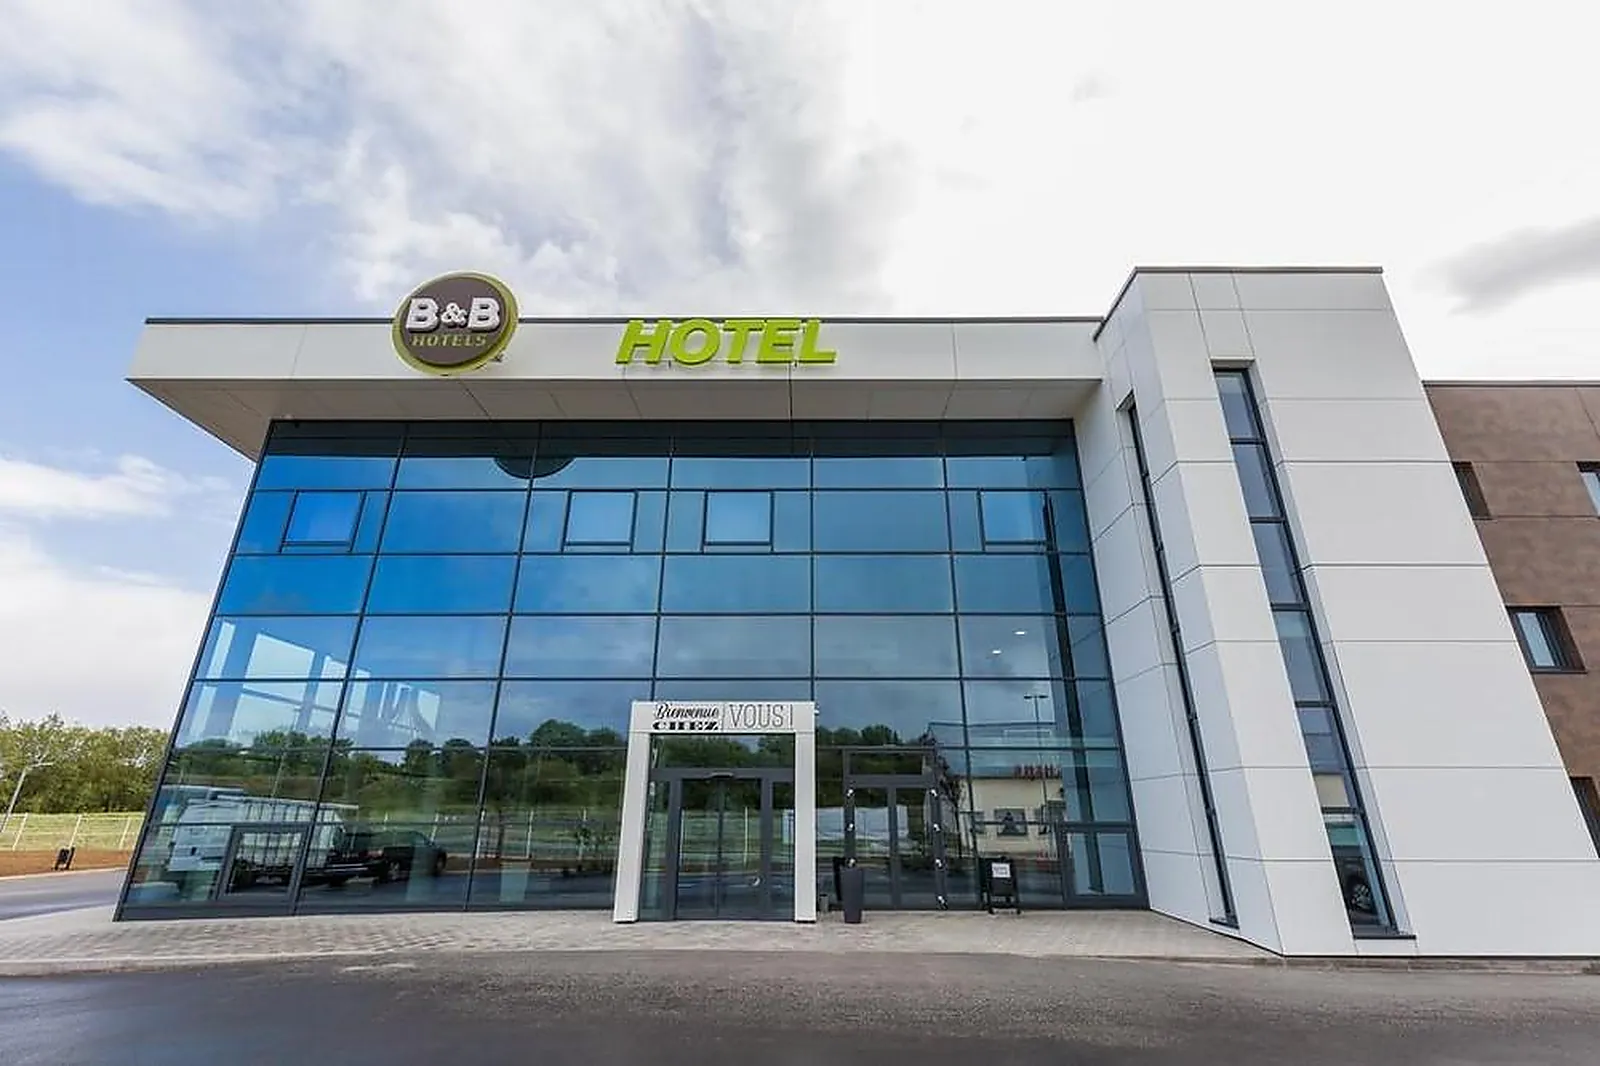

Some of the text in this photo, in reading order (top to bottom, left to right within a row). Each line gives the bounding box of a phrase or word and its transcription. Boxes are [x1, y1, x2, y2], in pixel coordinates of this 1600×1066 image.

[406, 297, 500, 331] B&B
[411, 334, 487, 347] HOTELS
[616, 318, 837, 365] HOTEL
[656, 703, 719, 719] Bienvenue
